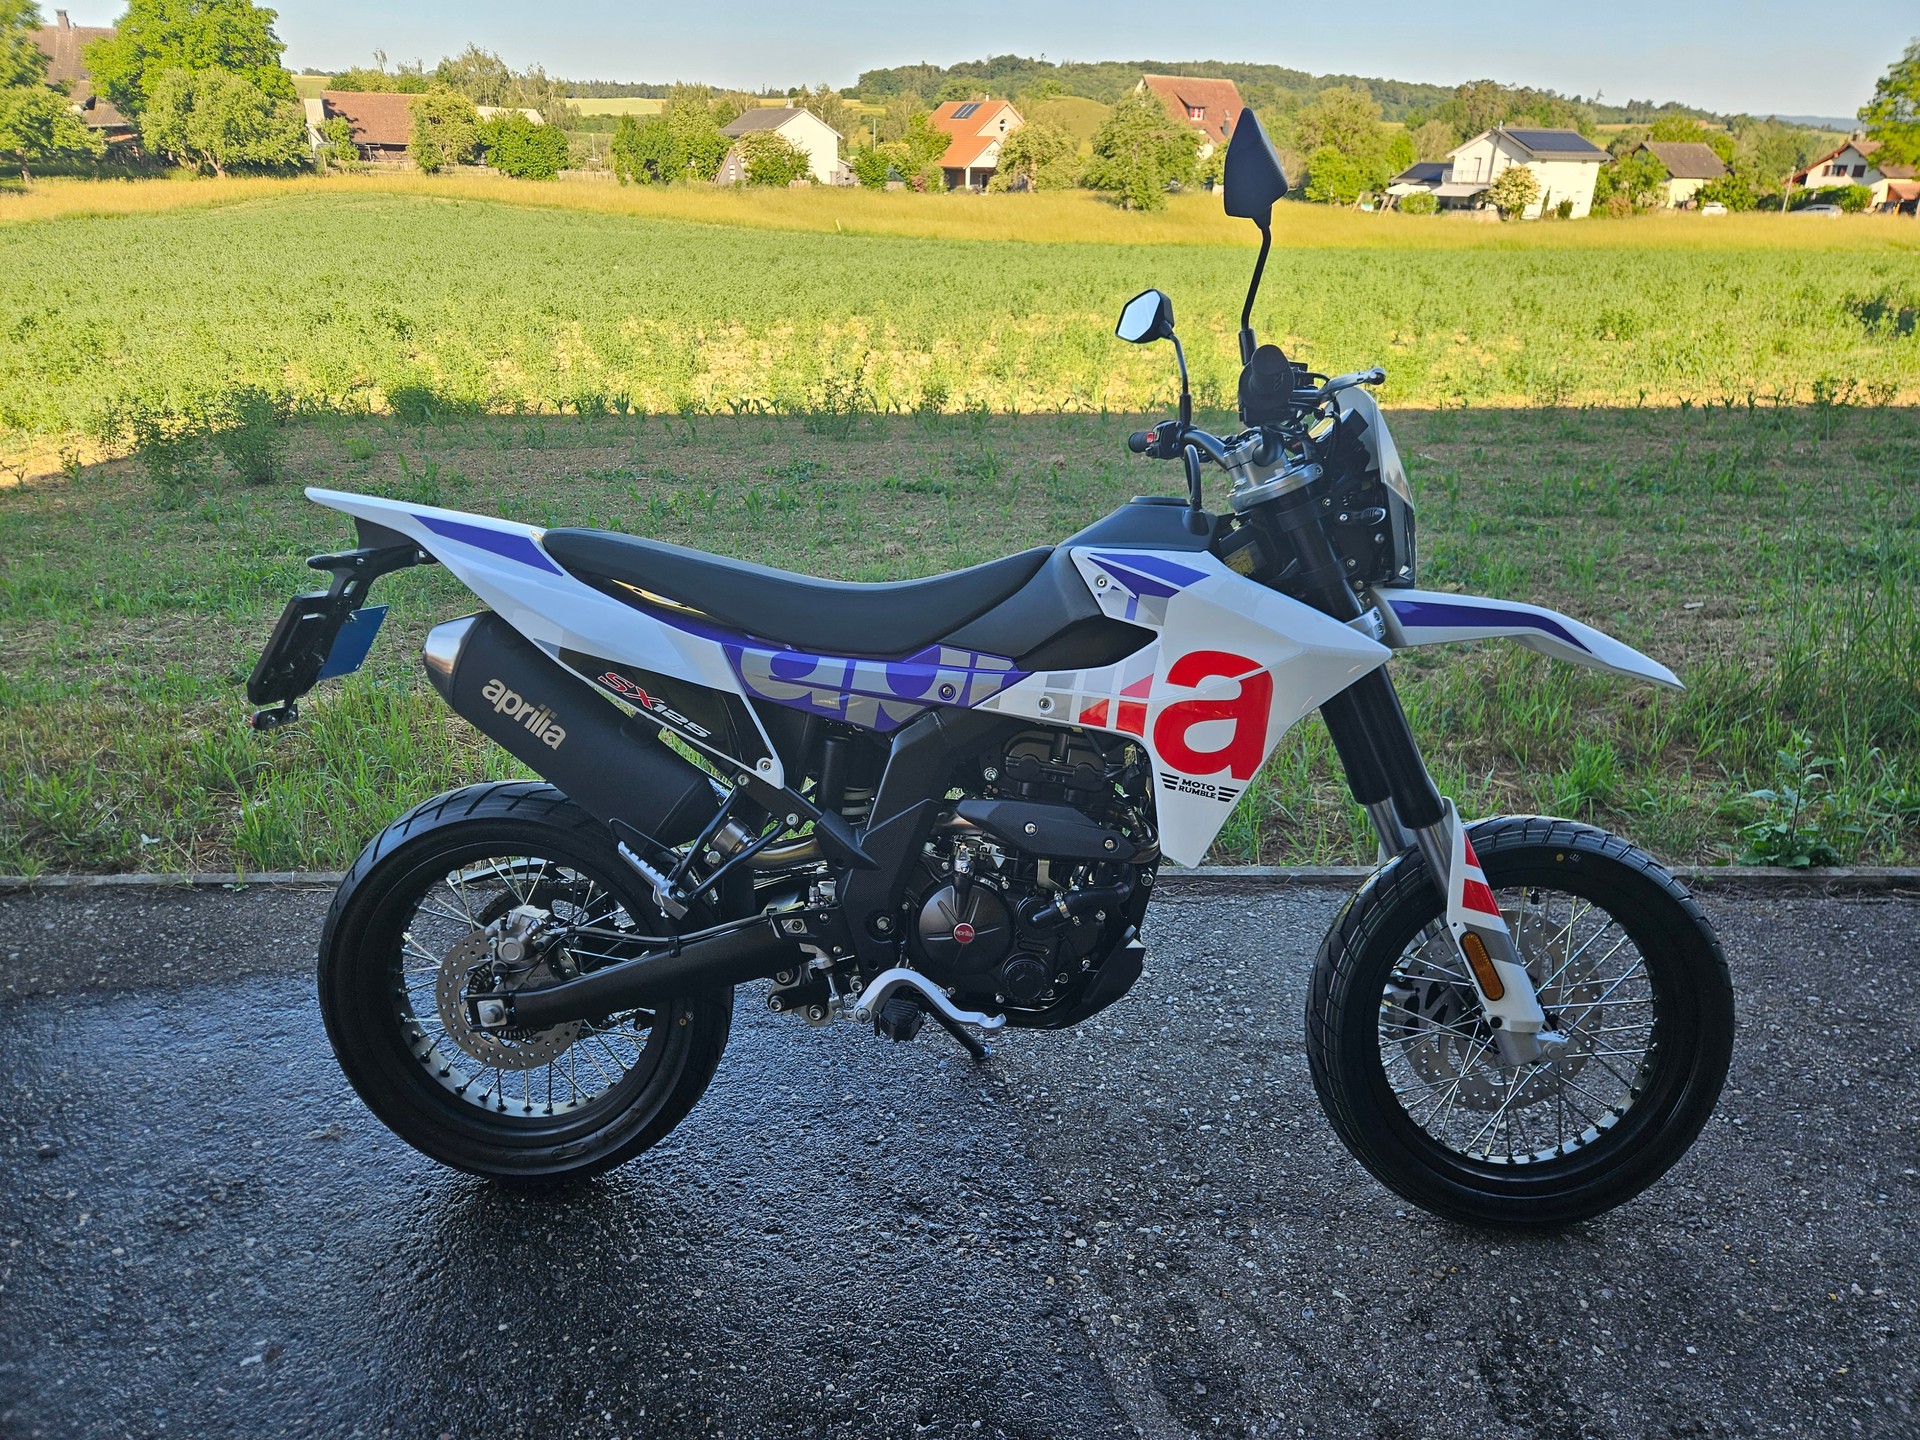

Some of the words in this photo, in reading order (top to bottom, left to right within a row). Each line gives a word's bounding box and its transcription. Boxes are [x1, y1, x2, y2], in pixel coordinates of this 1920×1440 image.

[481, 678, 567, 751] aprilia
[597, 671, 712, 738] SX125
[1178, 784, 1217, 800] RUMBLE
[1181, 778, 1216, 791] MOTO
